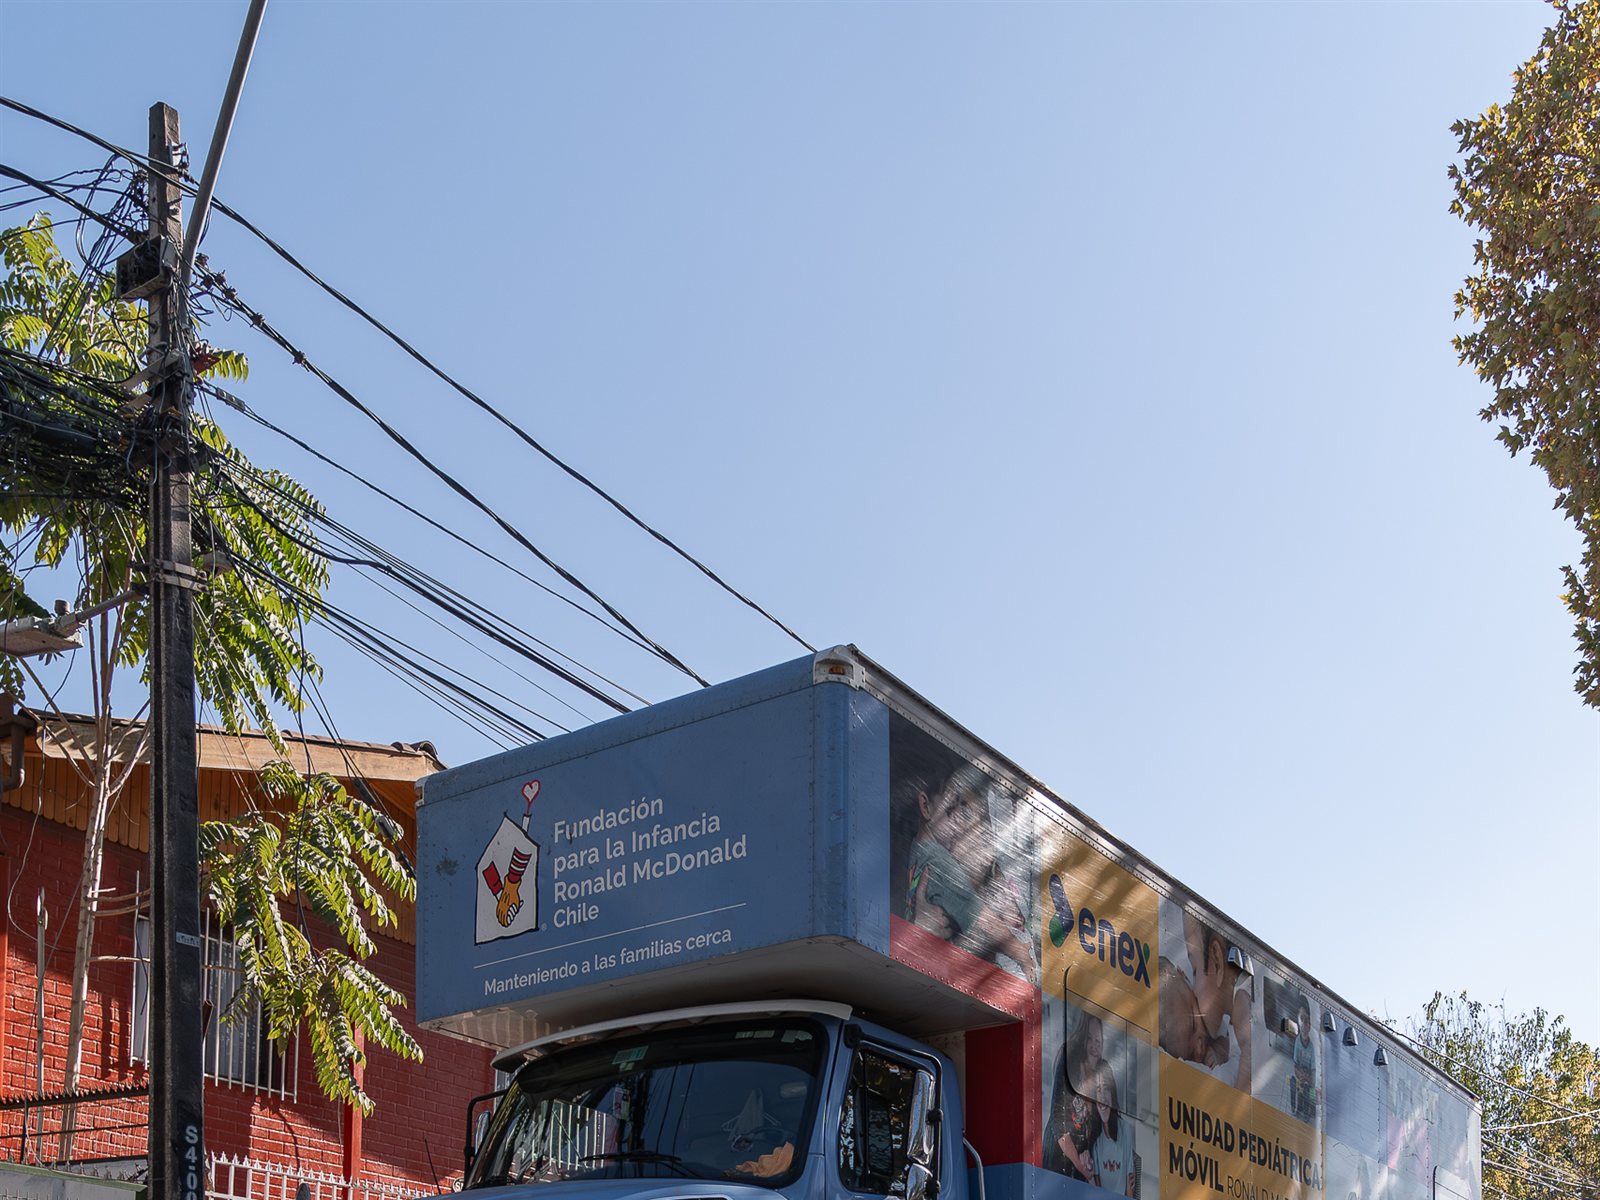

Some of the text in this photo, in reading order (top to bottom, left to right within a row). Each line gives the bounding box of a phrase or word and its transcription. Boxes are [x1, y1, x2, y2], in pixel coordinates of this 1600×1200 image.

[554, 797, 663, 843] Fundación
[554, 812, 720, 879] para la Infancia
[554, 834, 747, 903] Ronald McDonald
[553, 903, 599, 928] Chile
[484, 928, 732, 996] Manteniendo a las familias cerca
[1168, 1097, 1321, 1191] UNIDAD PEDIÁTRICA
[1169, 1142, 1224, 1193] MÓVIL
